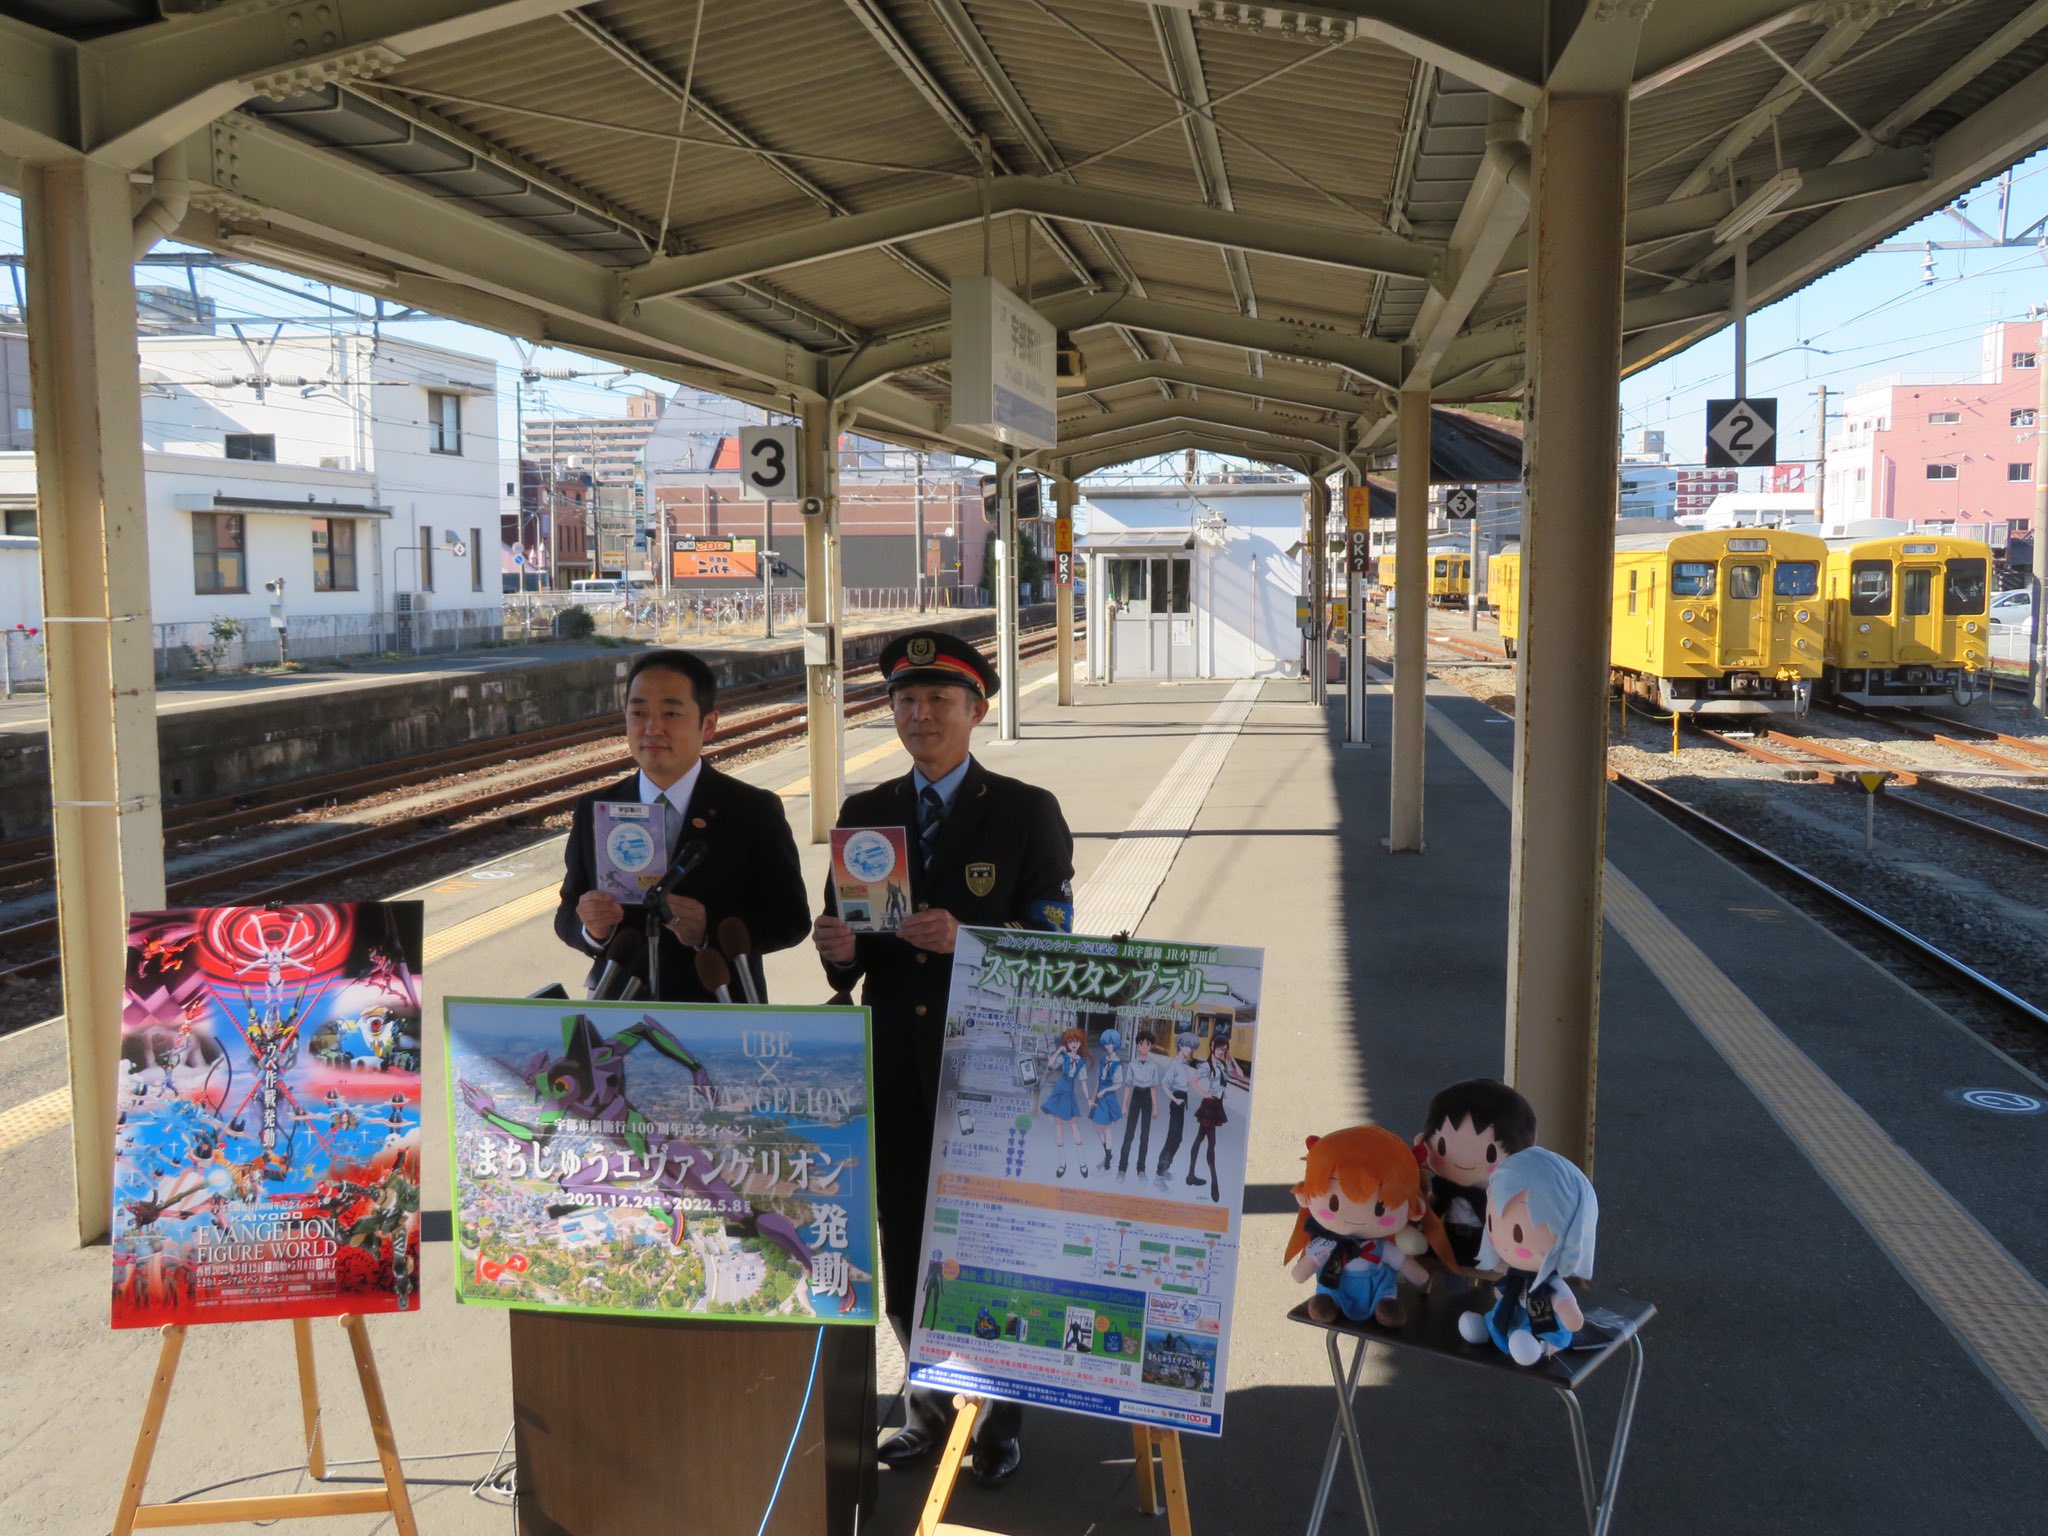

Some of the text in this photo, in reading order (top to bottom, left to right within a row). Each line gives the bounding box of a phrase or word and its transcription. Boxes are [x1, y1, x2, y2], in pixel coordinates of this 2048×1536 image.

[1729, 415, 1754, 451] 2
[751, 438, 786, 488] 3
[1353, 490, 1363, 528] ATS
[1456, 496, 1467, 512] 3
[1059, 520, 1069, 550] ATS
[1353, 531, 1364, 570] OK?
[1059, 553, 1069, 584] OK?
[980, 956, 1228, 1005] スマホスタンプラリー
[741, 1030, 794, 1058] UBE
[687, 1085, 851, 1115] EVANGELION
[475, 1136, 846, 1190] まちじゅうエヴァンゲリオン
[231, 1211, 303, 1222] KAIYODO
[672, 1197, 742, 1212] 2022.5.8
[198, 1218, 337, 1246] EVANGELION
[197, 1240, 337, 1263] FIGURE WORLD
[809, 1203, 849, 1297] 発動
